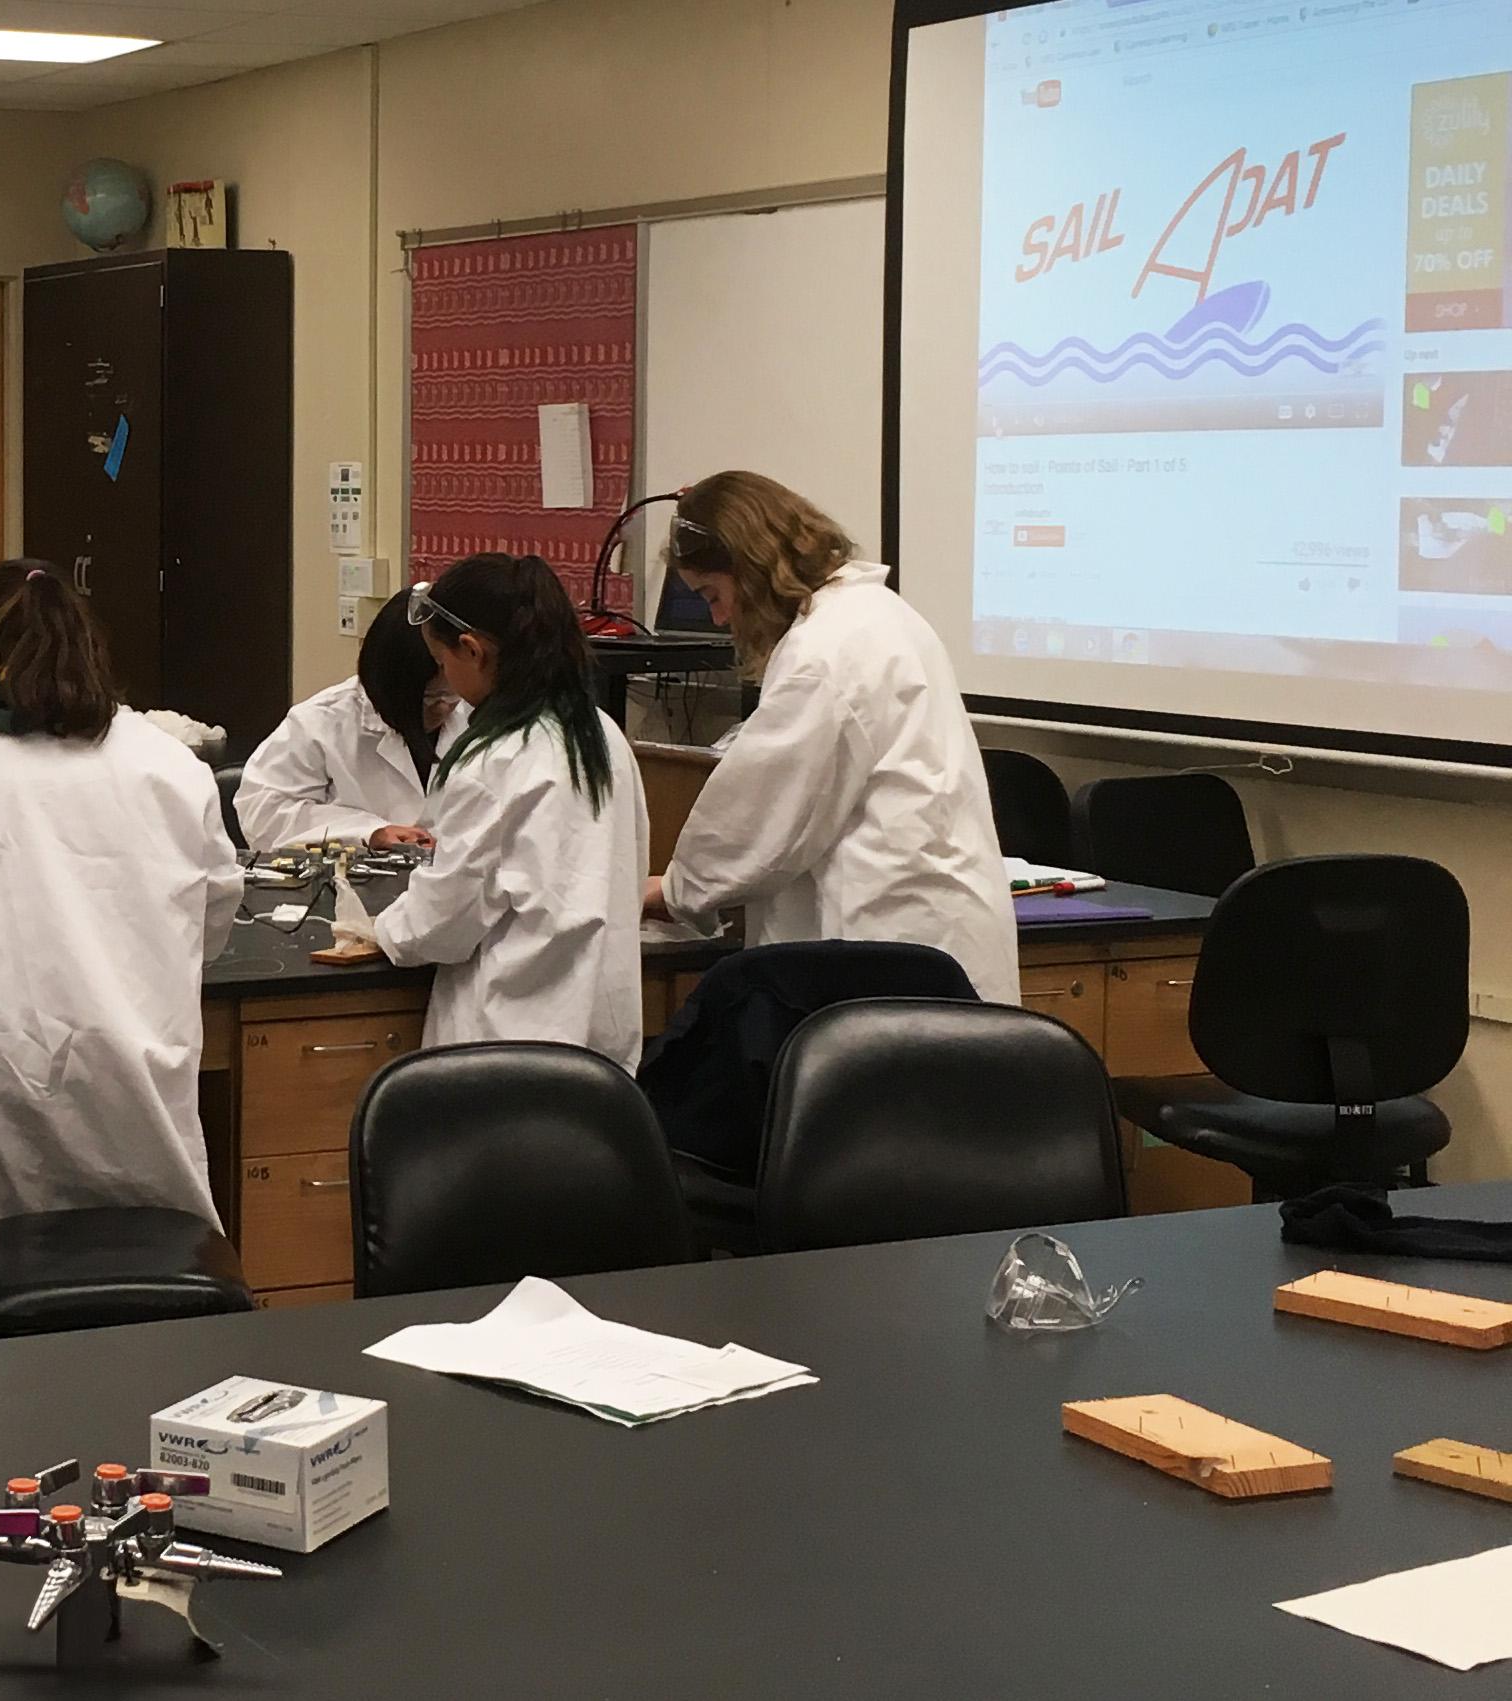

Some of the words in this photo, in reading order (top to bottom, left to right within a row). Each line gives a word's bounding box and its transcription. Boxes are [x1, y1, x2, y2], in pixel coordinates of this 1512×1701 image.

[1425, 161, 1487, 189] DAILY
[1421, 192, 1489, 219] DEALS
[1014, 187, 1125, 283] SAIL
[1414, 253, 1451, 272] 70%
[1456, 248, 1495, 271] OFF
[1008, 462, 1020, 474] to
[1048, 459, 1082, 474] Points
[1083, 459, 1096, 473] of
[1097, 458, 1120, 473] Sail
[1127, 458, 1151, 473] Part
[1163, 457, 1176, 472] of
[1177, 457, 1188, 472] 5
[158, 1431, 195, 1449] VWR
[310, 1447, 333, 1467] VWR
